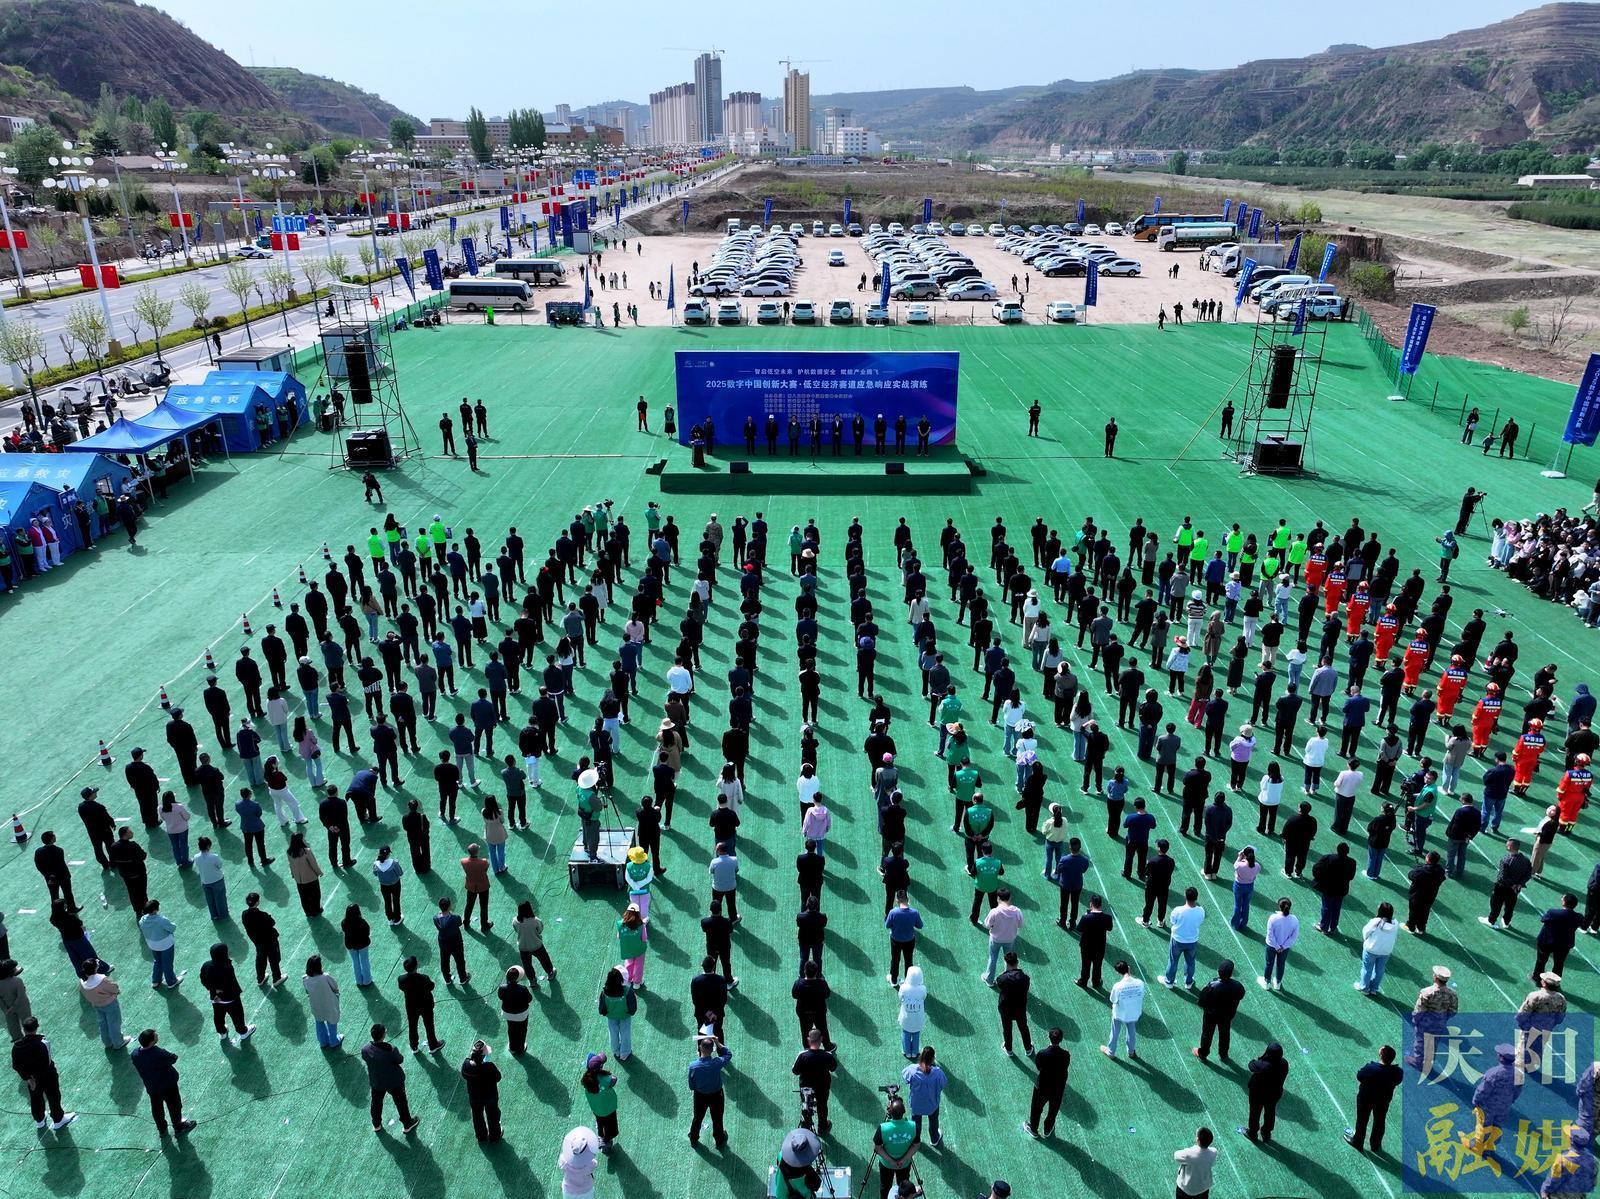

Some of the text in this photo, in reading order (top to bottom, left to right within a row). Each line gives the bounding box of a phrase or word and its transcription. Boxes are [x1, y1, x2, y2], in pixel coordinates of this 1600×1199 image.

[705, 379, 929, 390] 2025数字中国创新大赛·低空经济赛道应急响应实战演练
